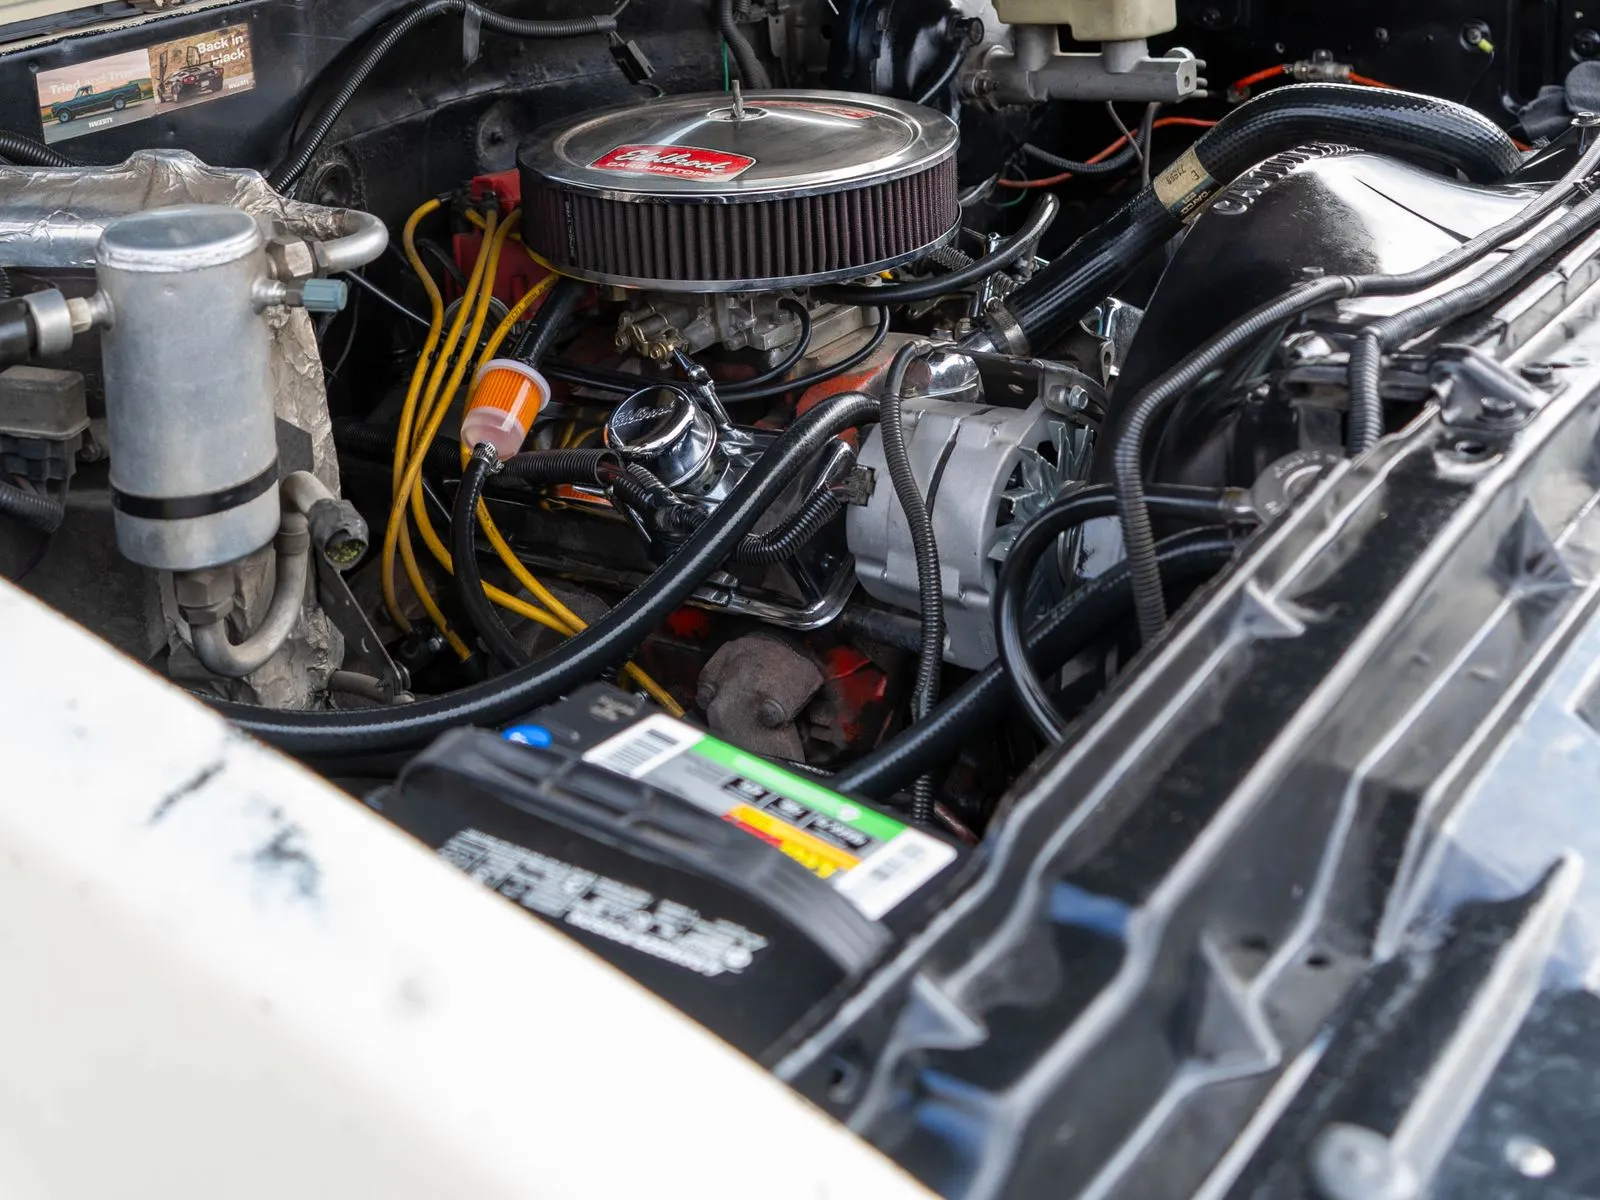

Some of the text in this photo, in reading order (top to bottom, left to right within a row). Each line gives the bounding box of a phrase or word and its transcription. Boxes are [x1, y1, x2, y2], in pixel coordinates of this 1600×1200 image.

[197, 34, 245, 54] Back in
[211, 49, 245, 66] black
[50, 78, 80, 95] Tried
[614, 148, 732, 172] Edelbrock
